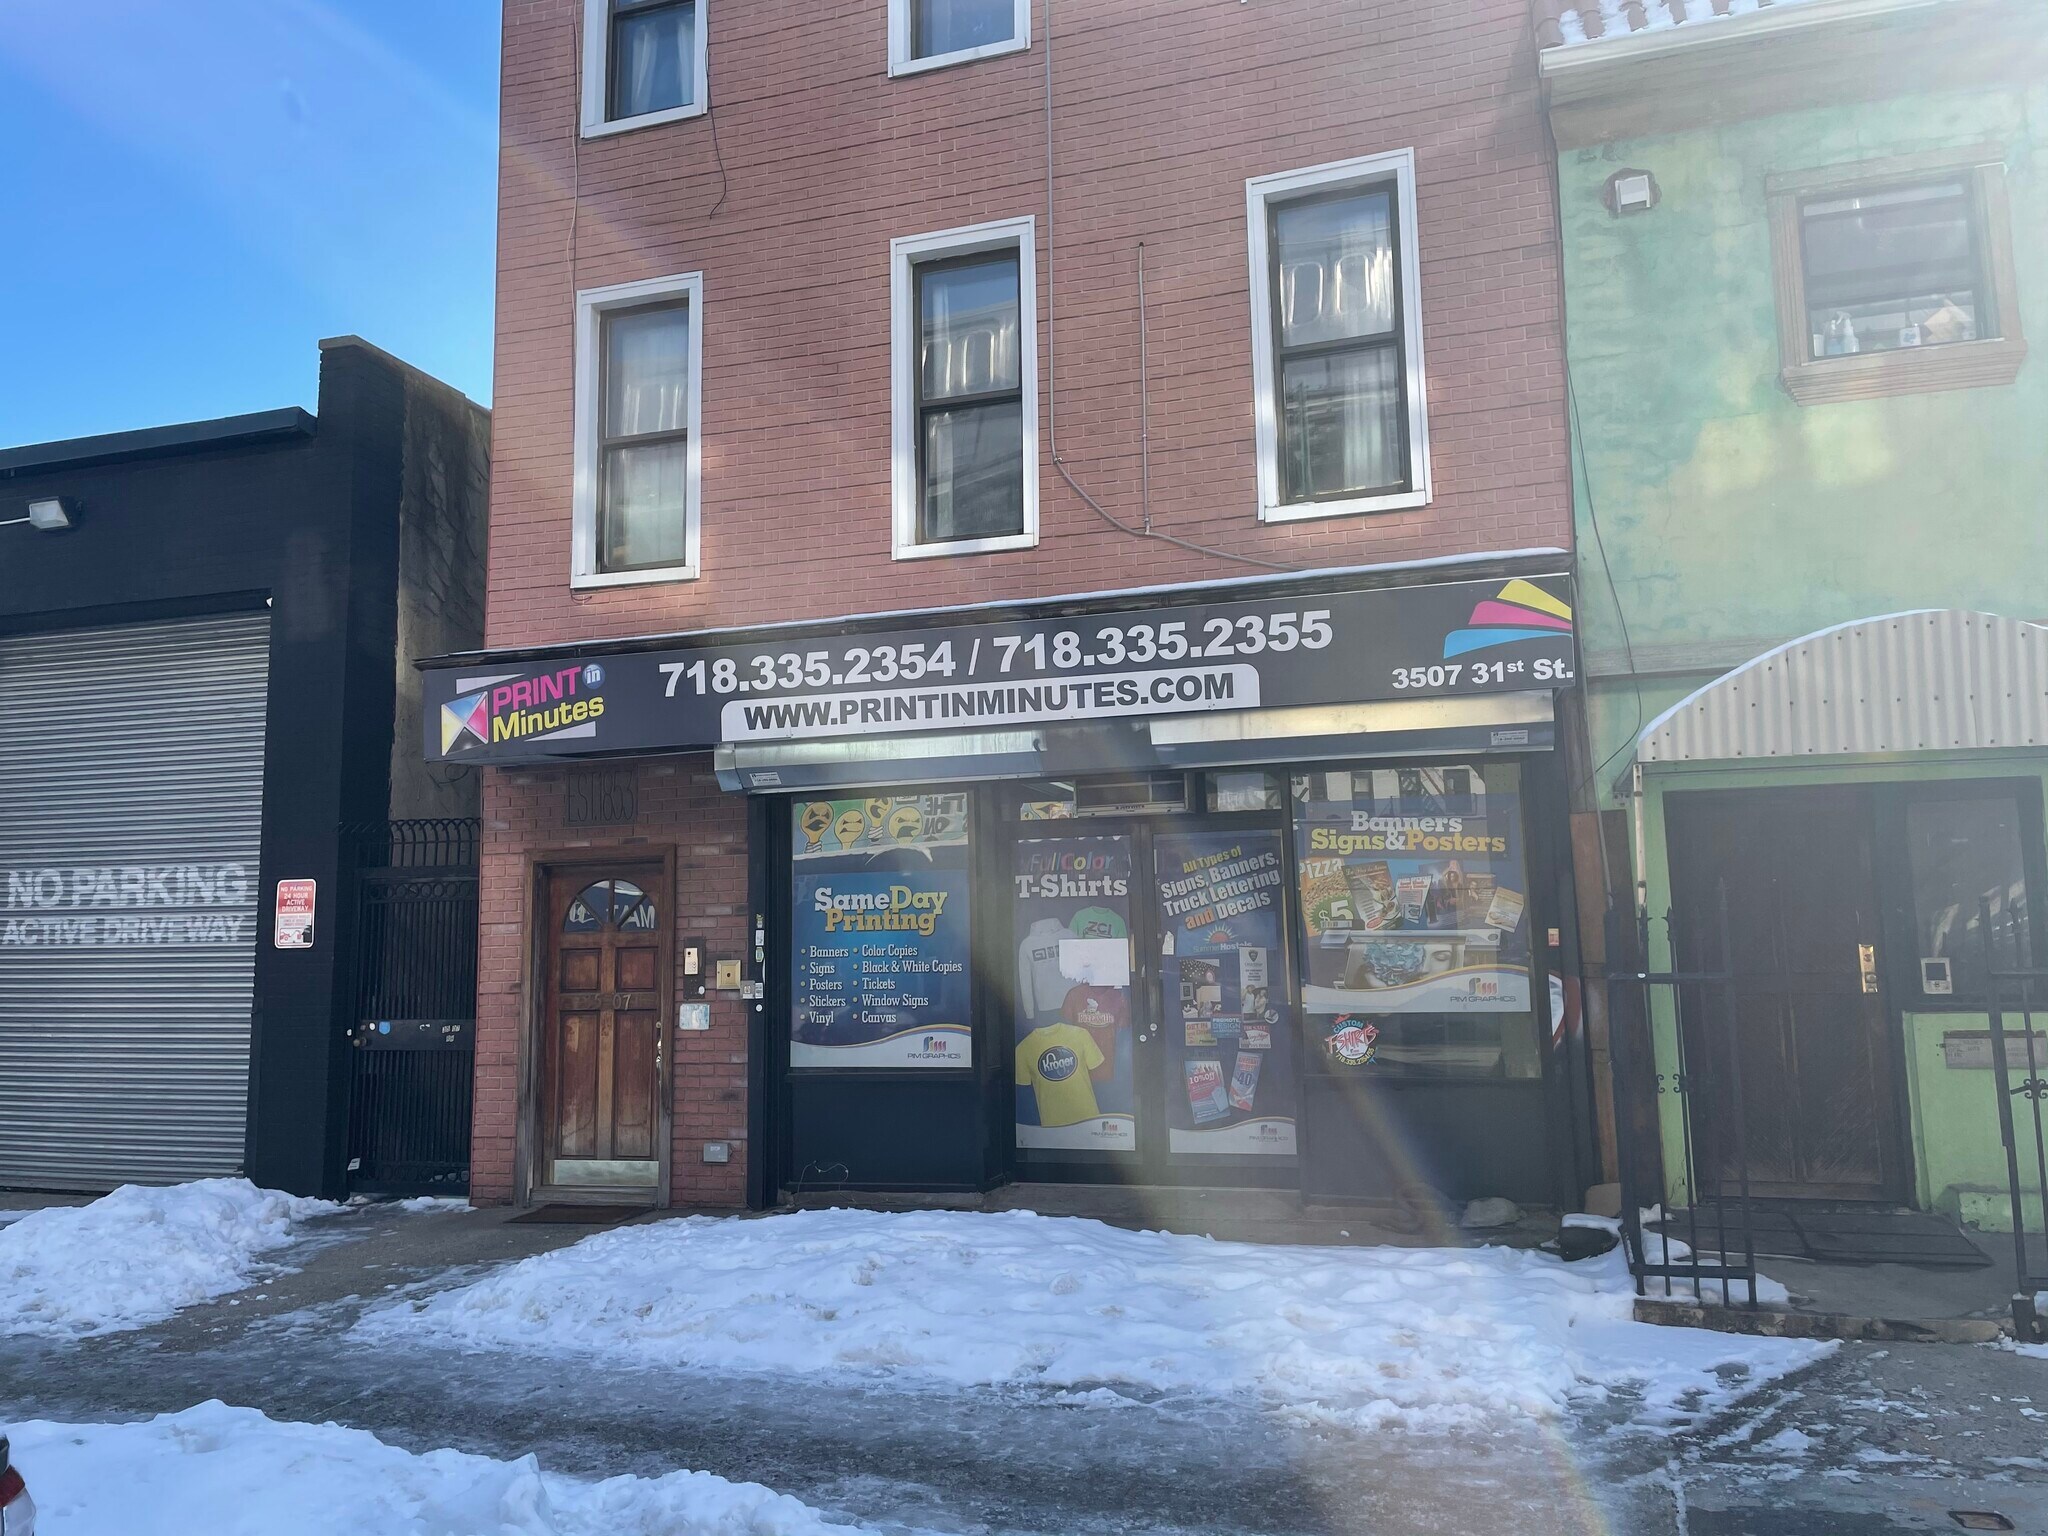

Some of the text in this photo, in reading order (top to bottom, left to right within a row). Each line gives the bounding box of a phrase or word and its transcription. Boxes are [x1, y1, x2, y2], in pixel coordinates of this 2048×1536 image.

[659, 609, 1333, 698] 718.335.2354 / 718.335.2355
[1391, 658, 1574, 690] 3507 31st St.
[492, 665, 602, 714] PRINT in
[744, 672, 1234, 731] WWW.PRINTINMINUTES.COM
[492, 695, 604, 743] Minutes
[1350, 810, 1463, 832] Banners
[1182, 845, 1242, 874] All Types of
[8, 863, 248, 909] NO PARKING
[1015, 873, 1128, 899] T-Shirts
[1160, 851, 1280, 899] Signs, Banners,
[1163, 869, 1281, 917] Truck Lettering
[825, 906, 937, 936] Printing
[1185, 891, 1271, 930] and Decals
[809, 945, 849, 957] Banners
[862, 944, 918, 959] Color Copies
[809, 962, 835, 977] Signs
[862, 960, 963, 975] Black & White Copies
[809, 978, 843, 991] Posters
[862, 977, 896, 990] Tickets
[809, 994, 847, 1007] Stickers
[862, 993, 929, 1008] Window Signs
[809, 1011, 834, 1026] Vinyl
[862, 1012, 897, 1024] Canvas
[1333, 1020, 1364, 1033] CUSTOM
[907, 1052, 962, 1060] PIM GRAPHICS
[1042, 1052, 1074, 1076] Kroger
